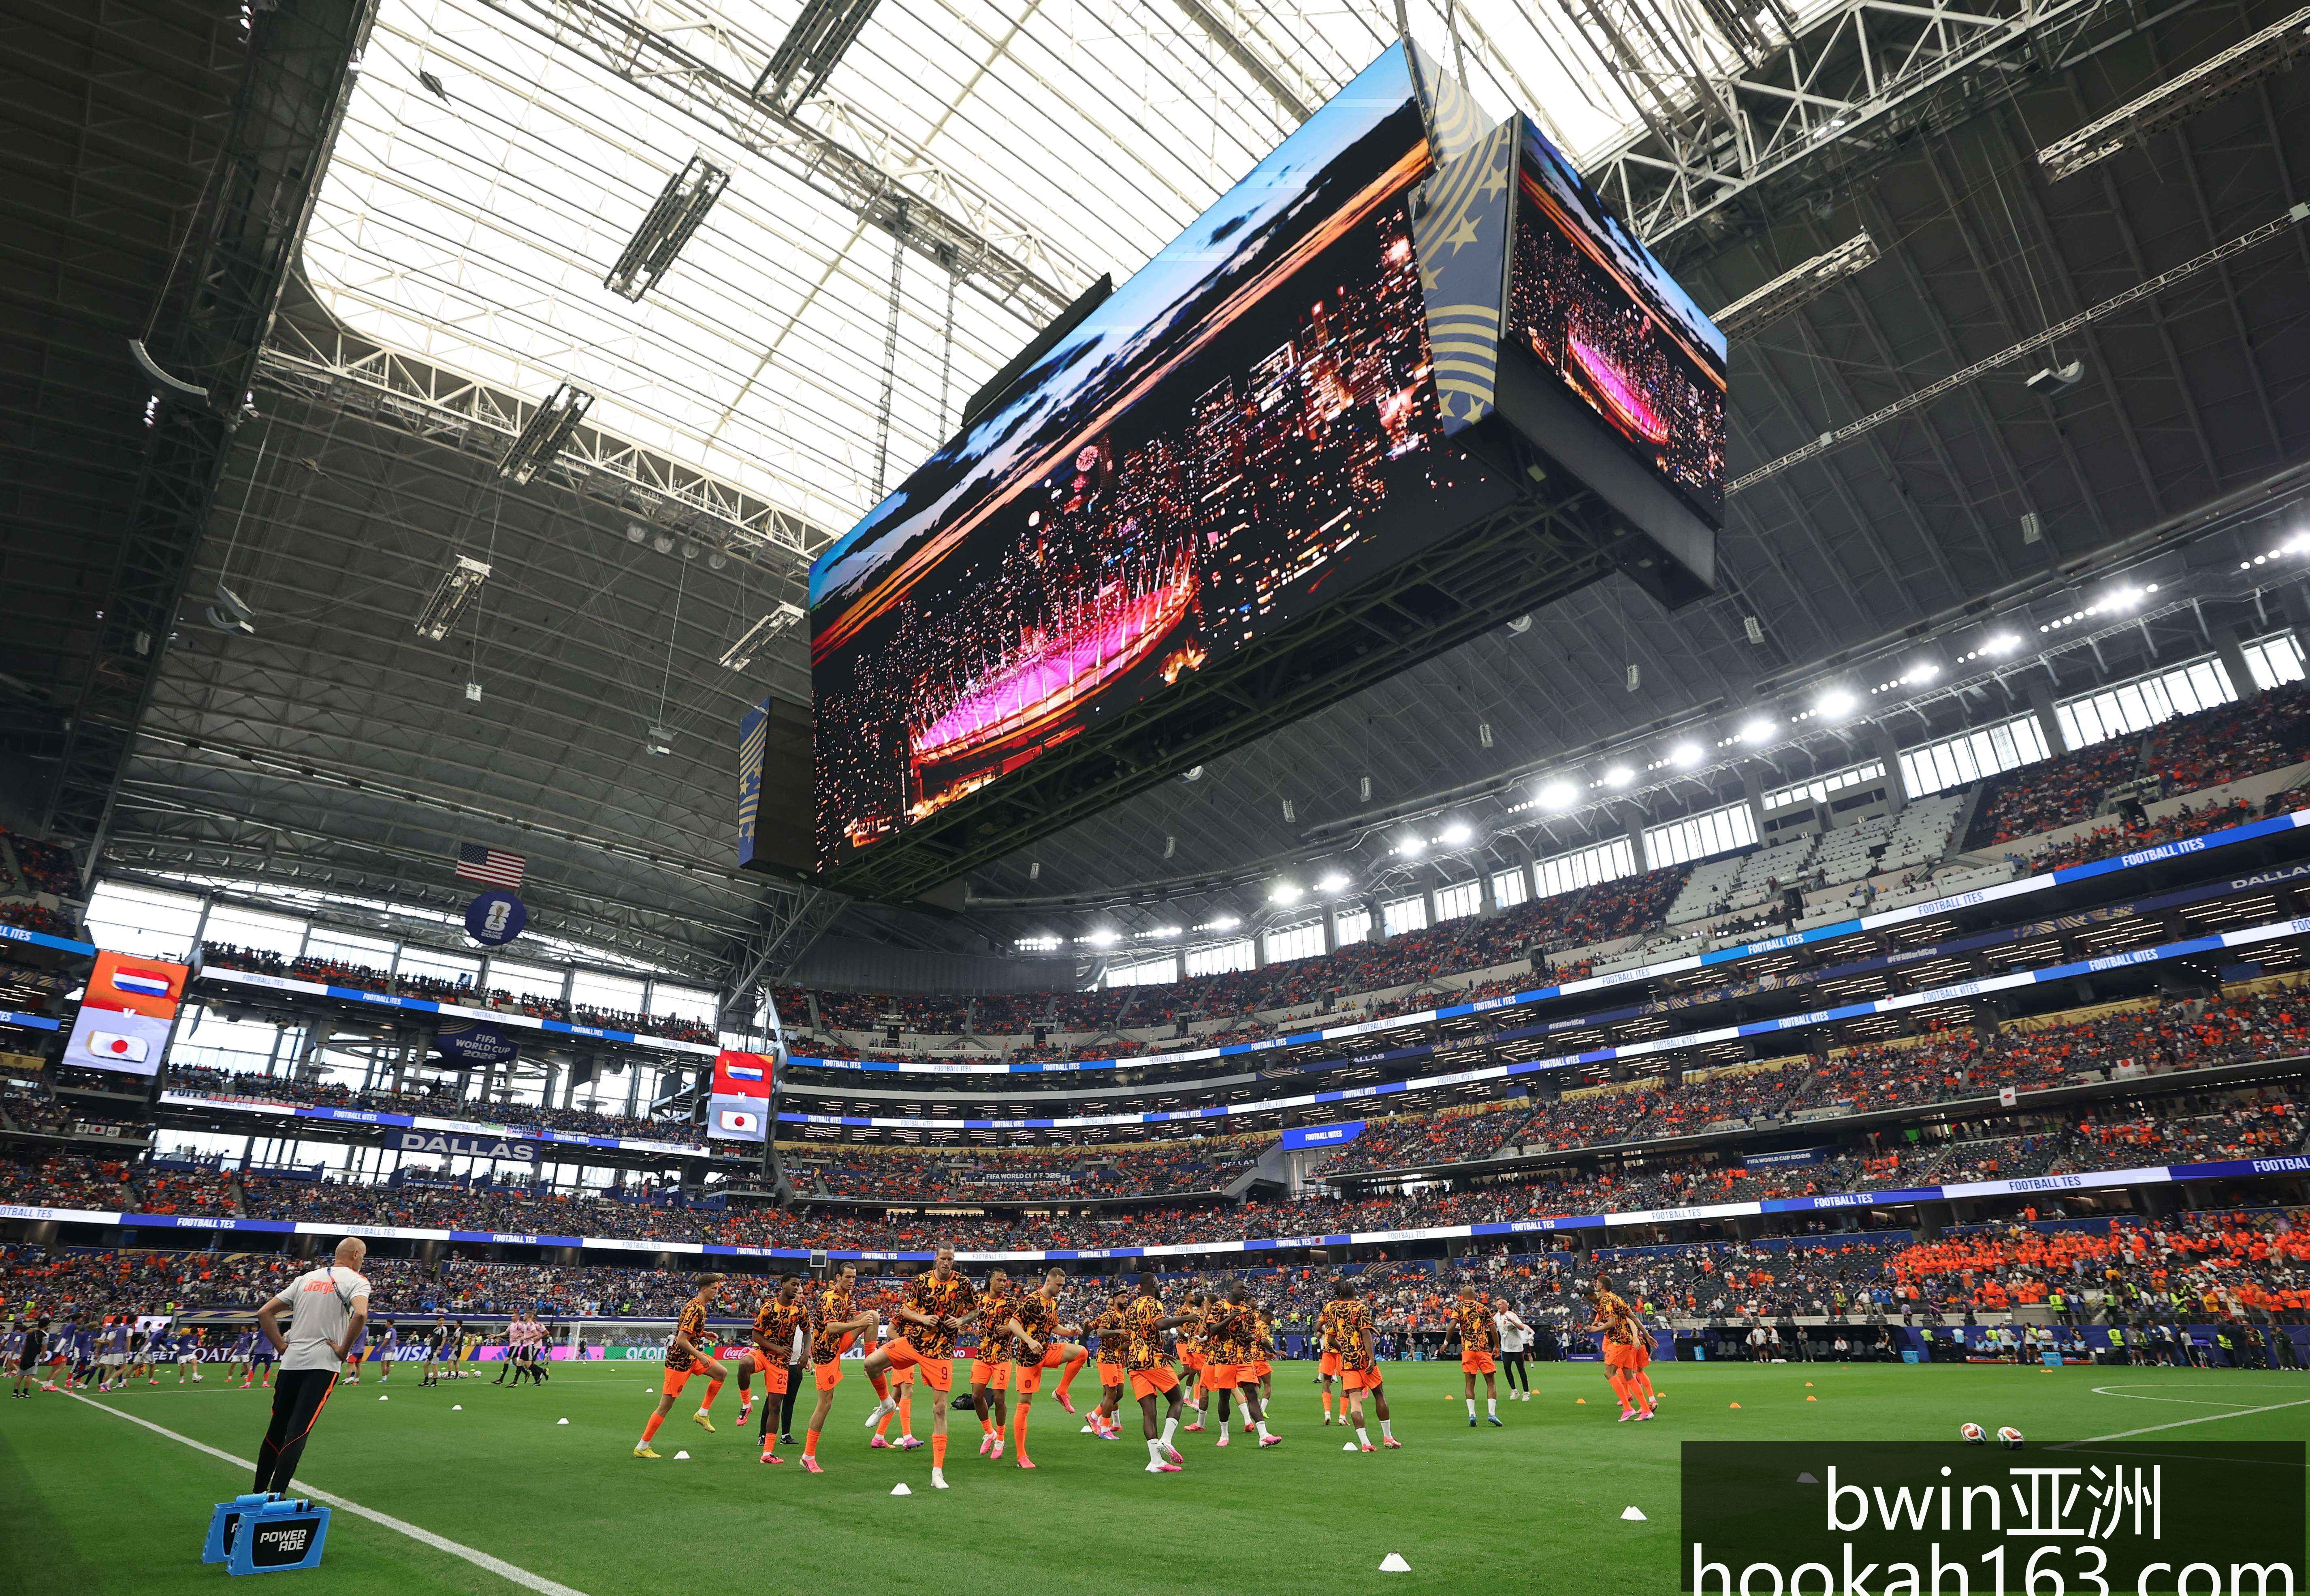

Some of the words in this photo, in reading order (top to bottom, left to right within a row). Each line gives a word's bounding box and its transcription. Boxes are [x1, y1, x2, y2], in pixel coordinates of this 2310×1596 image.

[2121, 845, 2178, 867] FOOTBALL
[2178, 838, 2205, 854] ITES
[1918, 898, 1962, 914] FOOTBALL
[1964, 892, 1984, 904] ITES
[1748, 938, 1786, 954] FOOTBALL
[1787, 934, 1804, 946] ITES
[1887, 948, 1938, 963] #FIFAWorldCup
[2088, 952, 2133, 971] FOOTBALL
[1602, 972, 1634, 985] FOOTBALL
[1636, 968, 1650, 978] ITES
[363, 993, 390, 1003] FOOTBALL
[1922, 987, 1959, 1001] FOOTBALL
[1473, 998, 1502, 1012] FOOTBALL
[1503, 995, 1516, 1006] ITES
[1357, 1021, 1383, 1032] FOOTBALL
[1549, 1019, 1585, 1030] #FIFAWorldCup
[1779, 1014, 1811, 1029] FOOTBALL
[571, 1026, 594, 1035] FOOTBALL
[475, 1033, 497, 1044] FIFA
[1653, 1038, 1681, 1050] FOOTBALL
[456, 1038, 491, 1051] WORLD
[492, 1046, 511, 1054] CUP
[1251, 1040, 1275, 1051] FOOTBALL
[462, 1049, 497, 1060] 2026
[1149, 1055, 1173, 1063] FOOTBALL
[1353, 1053, 1385, 1063] ALLAS
[823, 1059, 849, 1068] FOOTBALL
[1043, 1063, 1069, 1071] FOOTBALL
[1540, 1057, 1566, 1070] FOOTBALL
[1438, 1074, 1460, 1084] FOOTBALL
[1343, 1088, 1365, 1099] FOOTBALL
[1255, 1102, 1275, 1110] FOOTBALL
[333, 1110, 362, 1120] FOOTBALL
[808, 1114, 830, 1123] FOOTBALL
[1169, 1111, 1190, 1119] FOOTBALL
[449, 1123, 474, 1131] FOOTBALL
[1305, 1131, 1328, 1141] FOOTBALL
[400, 1133, 533, 1160] DALLAS
[2252, 1157, 2310, 1172] FOOTBAL
[2010, 1178, 2060, 1191] FOOTBALL
[2060, 1176, 2082, 1188] TES
[1814, 1194, 1856, 1208] FOOTBALL
[1856, 1193, 1874, 1204] TES
[0, 1207, 33, 1217] OTBALL
[1652, 1210, 1687, 1220] FOOTBALL
[1688, 1208, 1701, 1218] TES
[177, 1217, 218, 1228] FOOTBALL
[219, 1219, 235, 1229] TES
[1511, 1221, 1542, 1232] FOOTBALL
[1543, 1220, 1555, 1229] TES
[346, 1227, 382, 1235] FOOTBALL
[1388, 1231, 1415, 1239] FOOTBALL
[493, 1234, 525, 1243] FOOTBALL
[525, 1236, 537, 1244] TES
[1276, 1238, 1301, 1247] FOOTBALL
[1301, 1238, 1311, 1246] TES
[622, 1241, 651, 1250] FOOTBALL
[736, 1247, 761, 1255] FOOTBALL
[393, 1346, 432, 1361] VISA
[941, 1367, 948, 1380] 9
[999, 1370, 1005, 1381] 5
[260, 1529, 307, 1543] POWER
[278, 1539, 305, 1551] ADE
